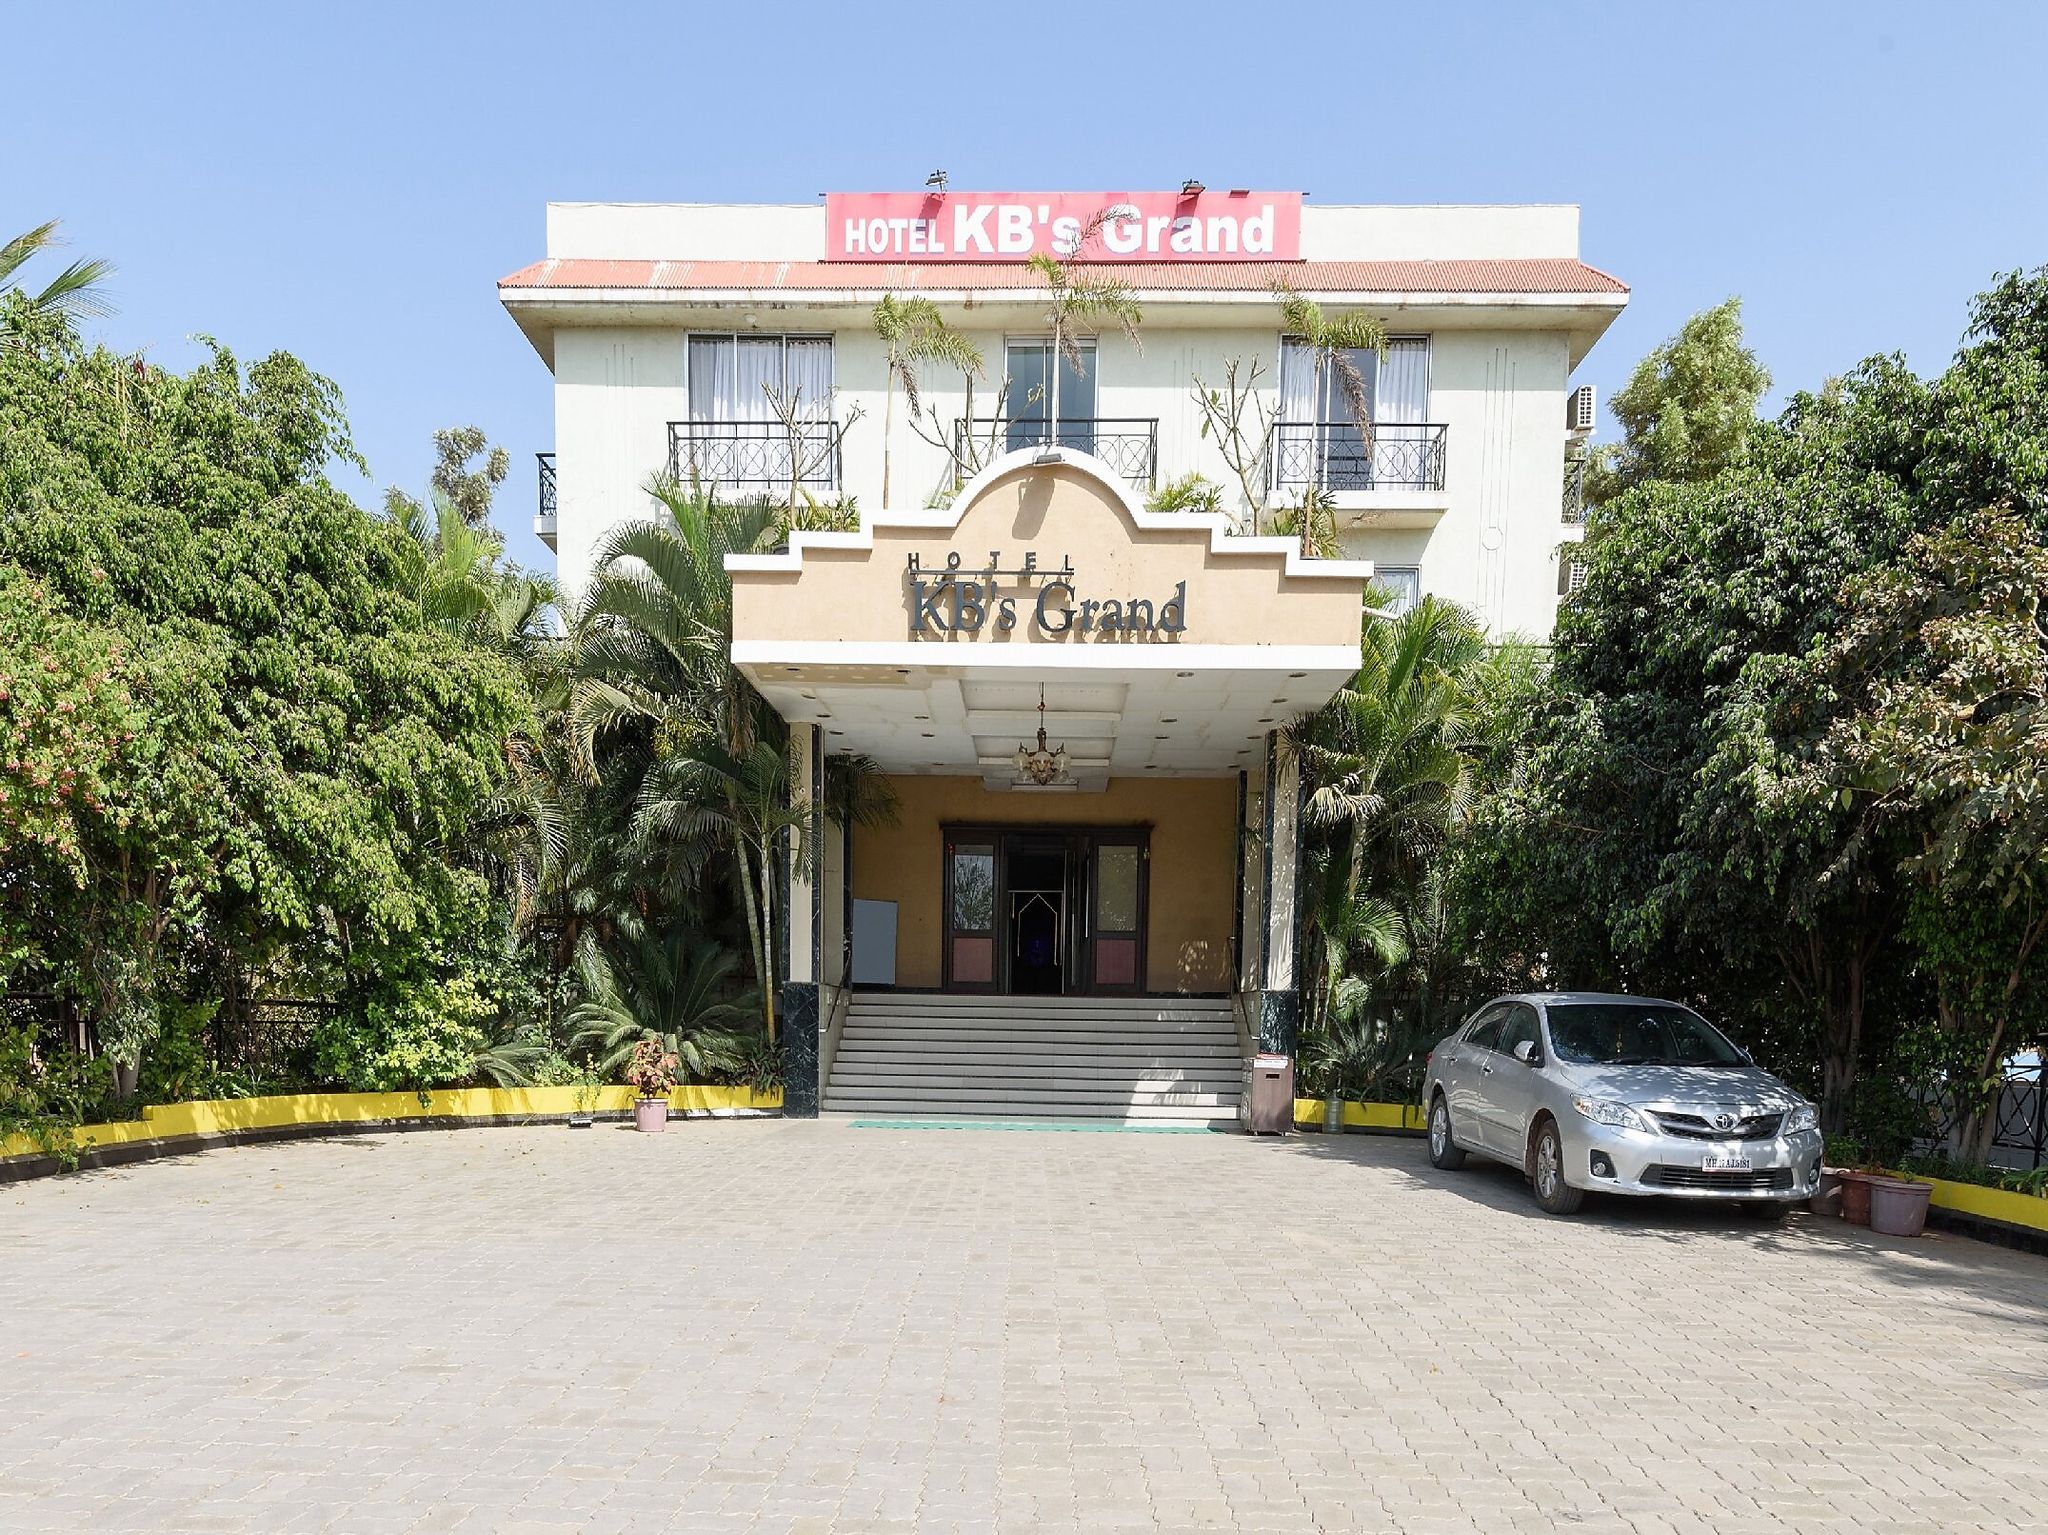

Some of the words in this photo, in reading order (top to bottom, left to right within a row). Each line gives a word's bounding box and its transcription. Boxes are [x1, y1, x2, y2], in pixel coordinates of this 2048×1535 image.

[845, 218, 944, 254] HOTEL
[954, 204, 1081, 254] KB's
[1102, 203, 1275, 255] Grand
[907, 551, 1075, 571] HOTEL
[910, 580, 1016, 632] KB's
[1036, 579, 1188, 633] Grand
